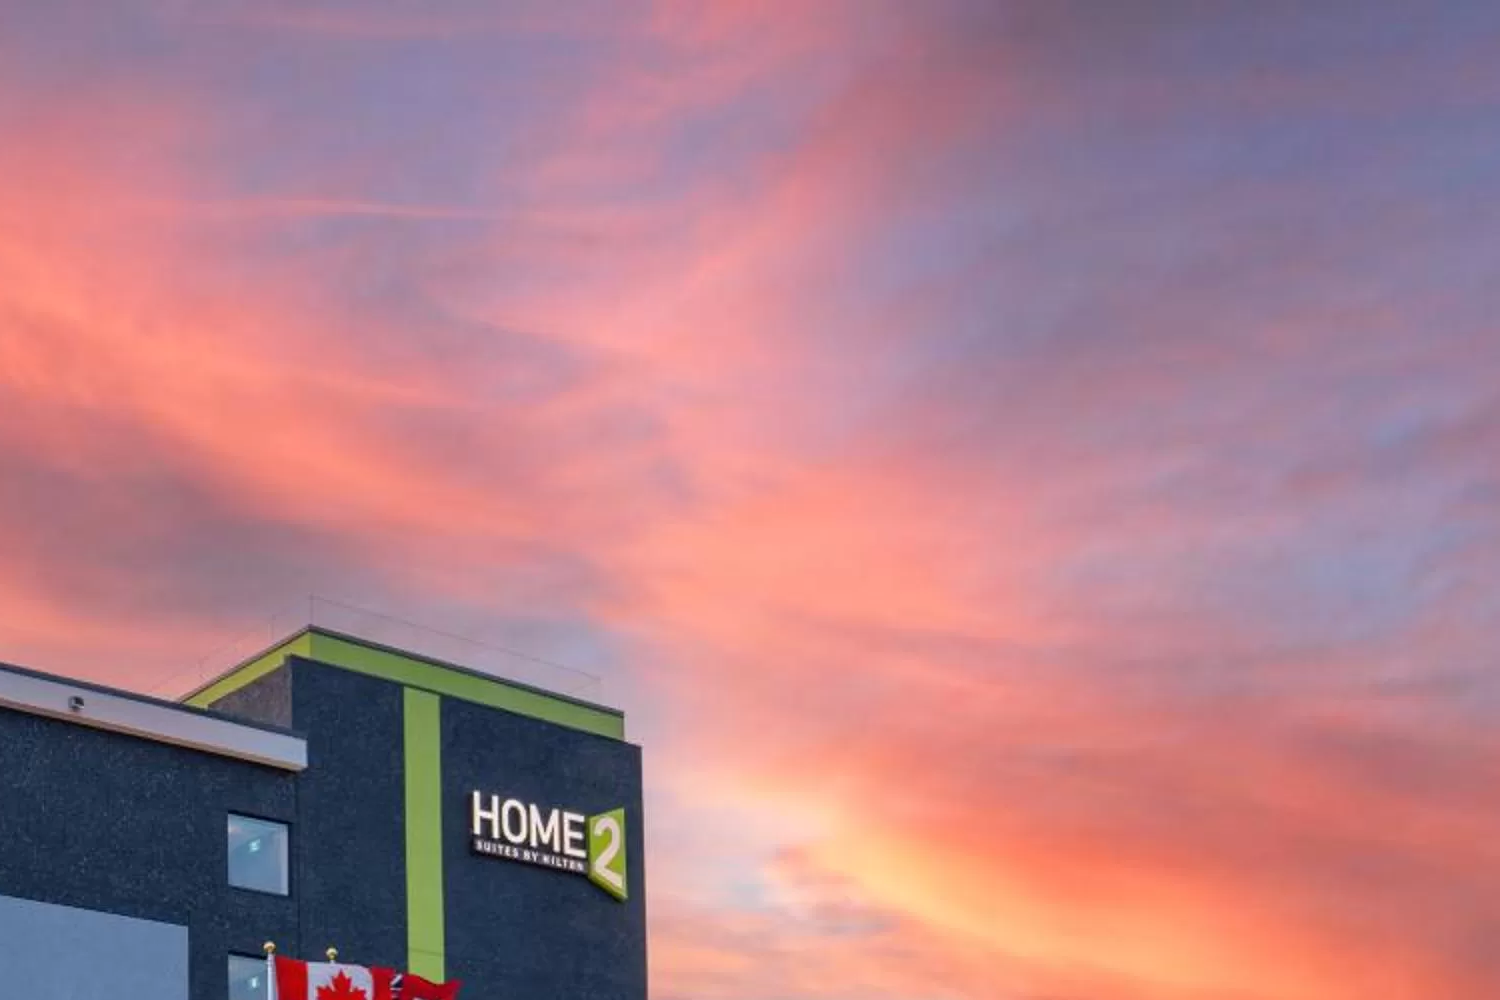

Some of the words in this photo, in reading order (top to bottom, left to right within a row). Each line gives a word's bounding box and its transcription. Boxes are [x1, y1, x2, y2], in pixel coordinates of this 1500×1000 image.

[473, 790, 587, 859] HOME
[593, 817, 623, 889] 2
[476, 840, 519, 858] SUITES
[523, 849, 539, 862] BY
[543, 855, 585, 872] HILTON
